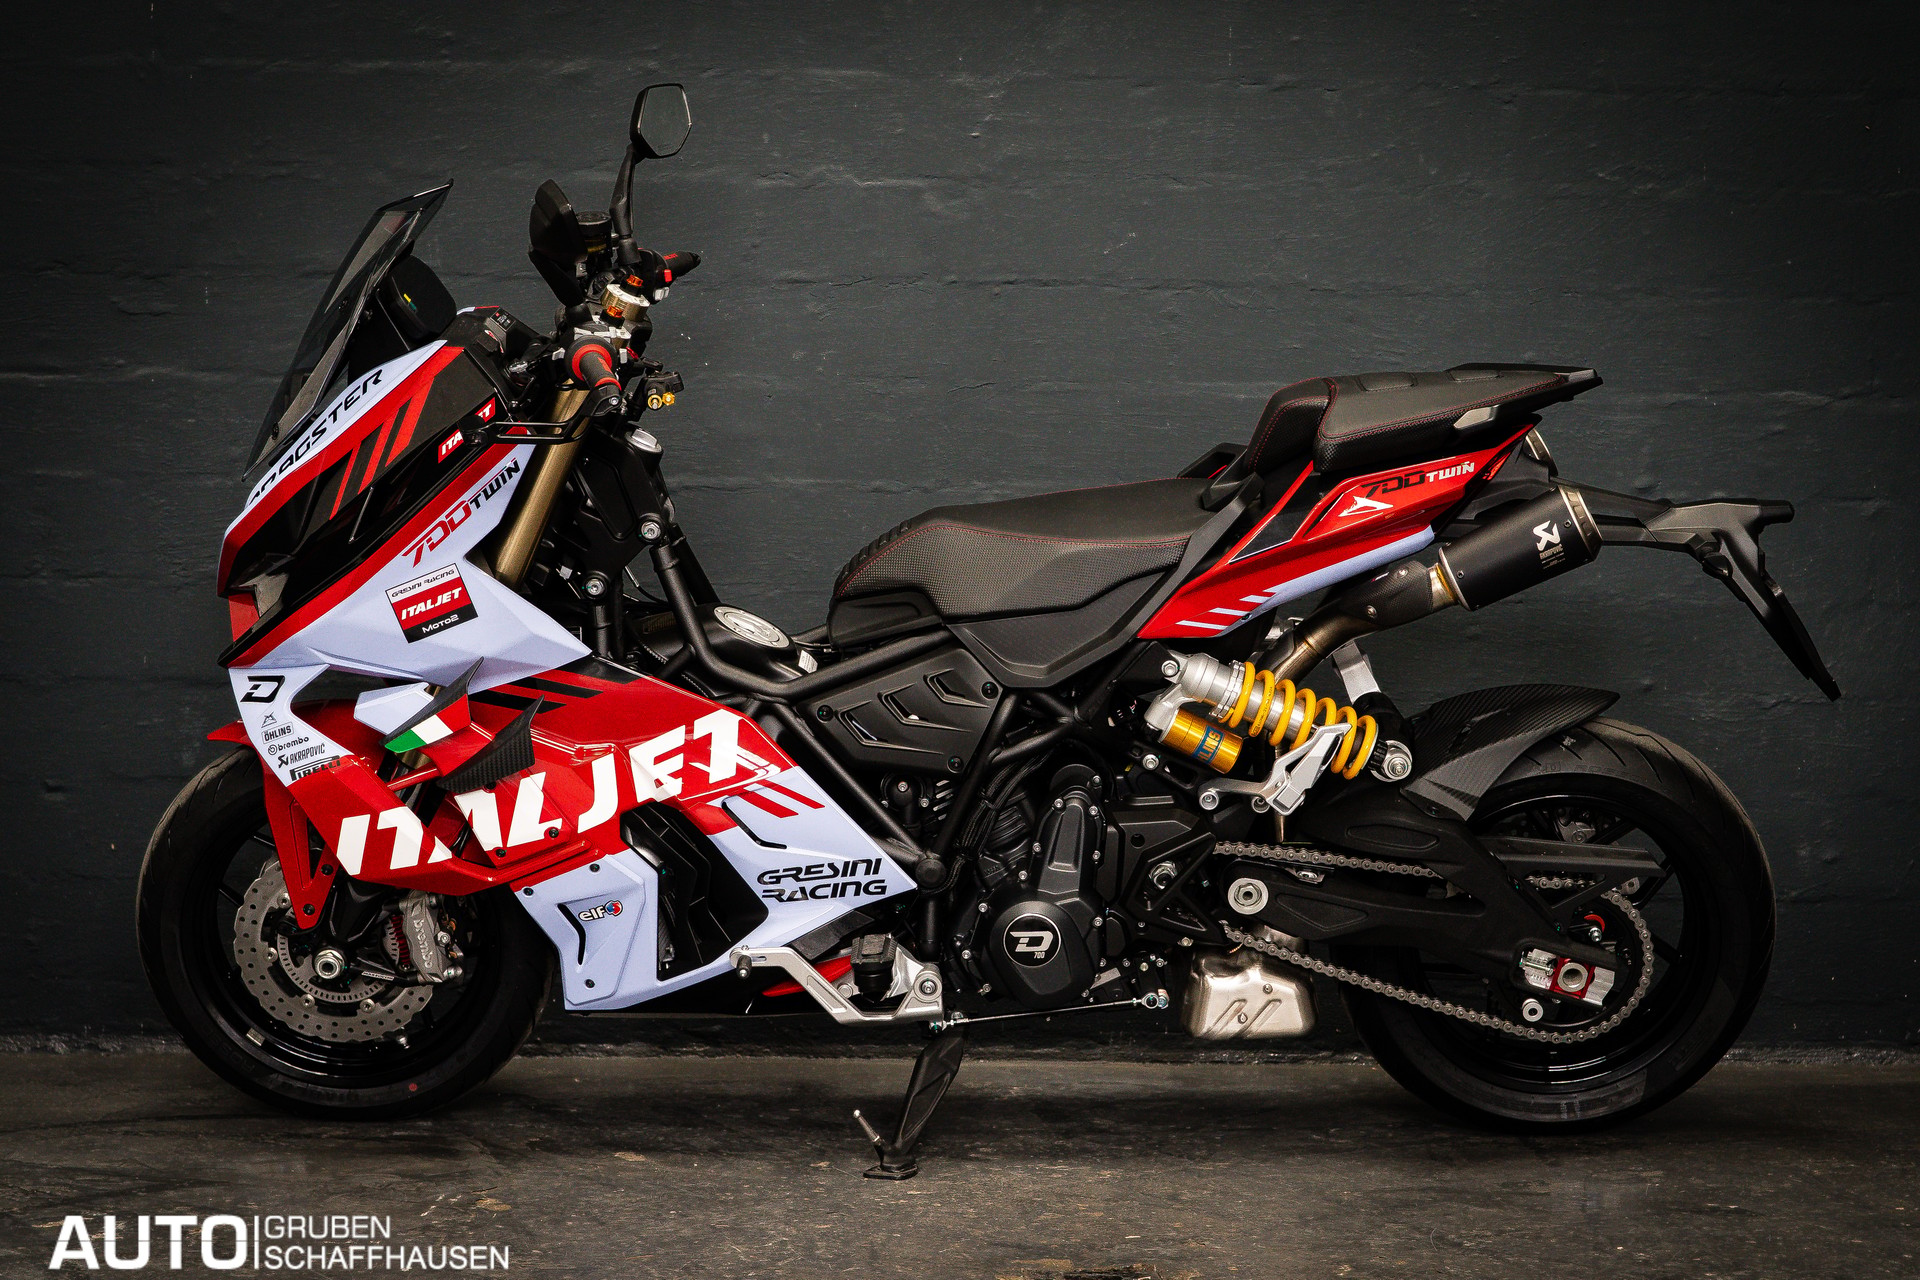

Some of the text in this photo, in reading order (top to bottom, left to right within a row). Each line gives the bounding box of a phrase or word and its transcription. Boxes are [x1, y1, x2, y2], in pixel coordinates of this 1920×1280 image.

[401, 587, 462, 620] ITALJET
[277, 736, 310, 751] brembo
[289, 755, 341, 781] PIRELLI
[757, 858, 882, 885] GRESINI
[762, 879, 887, 902] RACING
[578, 905, 605, 921] elf
[413, 918, 434, 969] brembo
